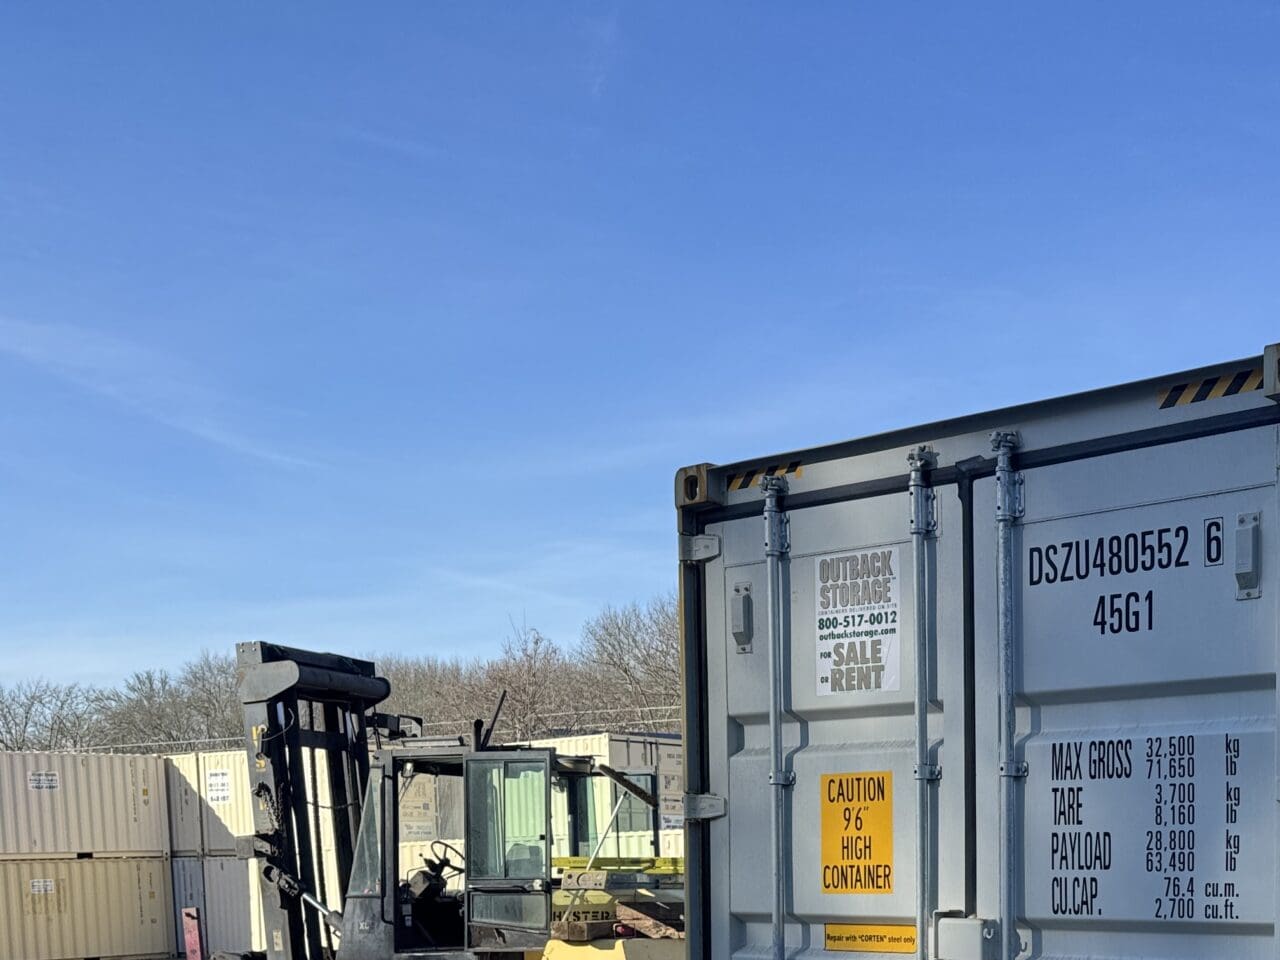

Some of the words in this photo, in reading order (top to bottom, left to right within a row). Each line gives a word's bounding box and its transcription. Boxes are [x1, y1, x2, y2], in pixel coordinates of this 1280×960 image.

[1029, 525, 1189, 586] DSZU480552
[1206, 521, 1221, 563] 6
[819, 551, 893, 584] OUTBACK
[820, 577, 892, 609] STORAGE
[818, 611, 897, 630] 800-517-0012
[1093, 590, 1153, 635] 45G1
[819, 628, 896, 641] outbackstorage.com
[833, 639, 882, 667] SALE
[831, 665, 884, 692] RENT
[1146, 735, 1195, 758] 32,500
[1225, 733, 1240, 758] kg
[1051, 742, 1082, 781] MAX
[1089, 739, 1132, 779] GROSS
[1146, 757, 1195, 780] 71,650
[1226, 756, 1236, 776] lb
[828, 776, 885, 803] CAUTION
[1155, 783, 1195, 805] 3,700
[1226, 782, 1240, 806] kg
[1052, 787, 1083, 825] TARE
[1155, 804, 1195, 826] 8,160
[1226, 804, 1237, 824] lb
[841, 835, 872, 860] HIGH
[1051, 832, 1111, 870] PAYLOAD
[1146, 830, 1195, 852] 28,800
[1225, 829, 1240, 854] kg
[1146, 852, 1195, 873] 63,490
[1225, 851, 1236, 871] lb
[823, 864, 891, 889] CONTAINER
[1164, 877, 1195, 897] 76.4
[1205, 882, 1239, 897] cu.m.
[1051, 877, 1102, 915] CU.CAP.
[1155, 898, 1195, 920] 2,700
[1204, 901, 1239, 919] cu.ft.
[827, 934, 844, 943] Repair
[845, 934, 857, 942] with
[903, 937, 916, 945] only
